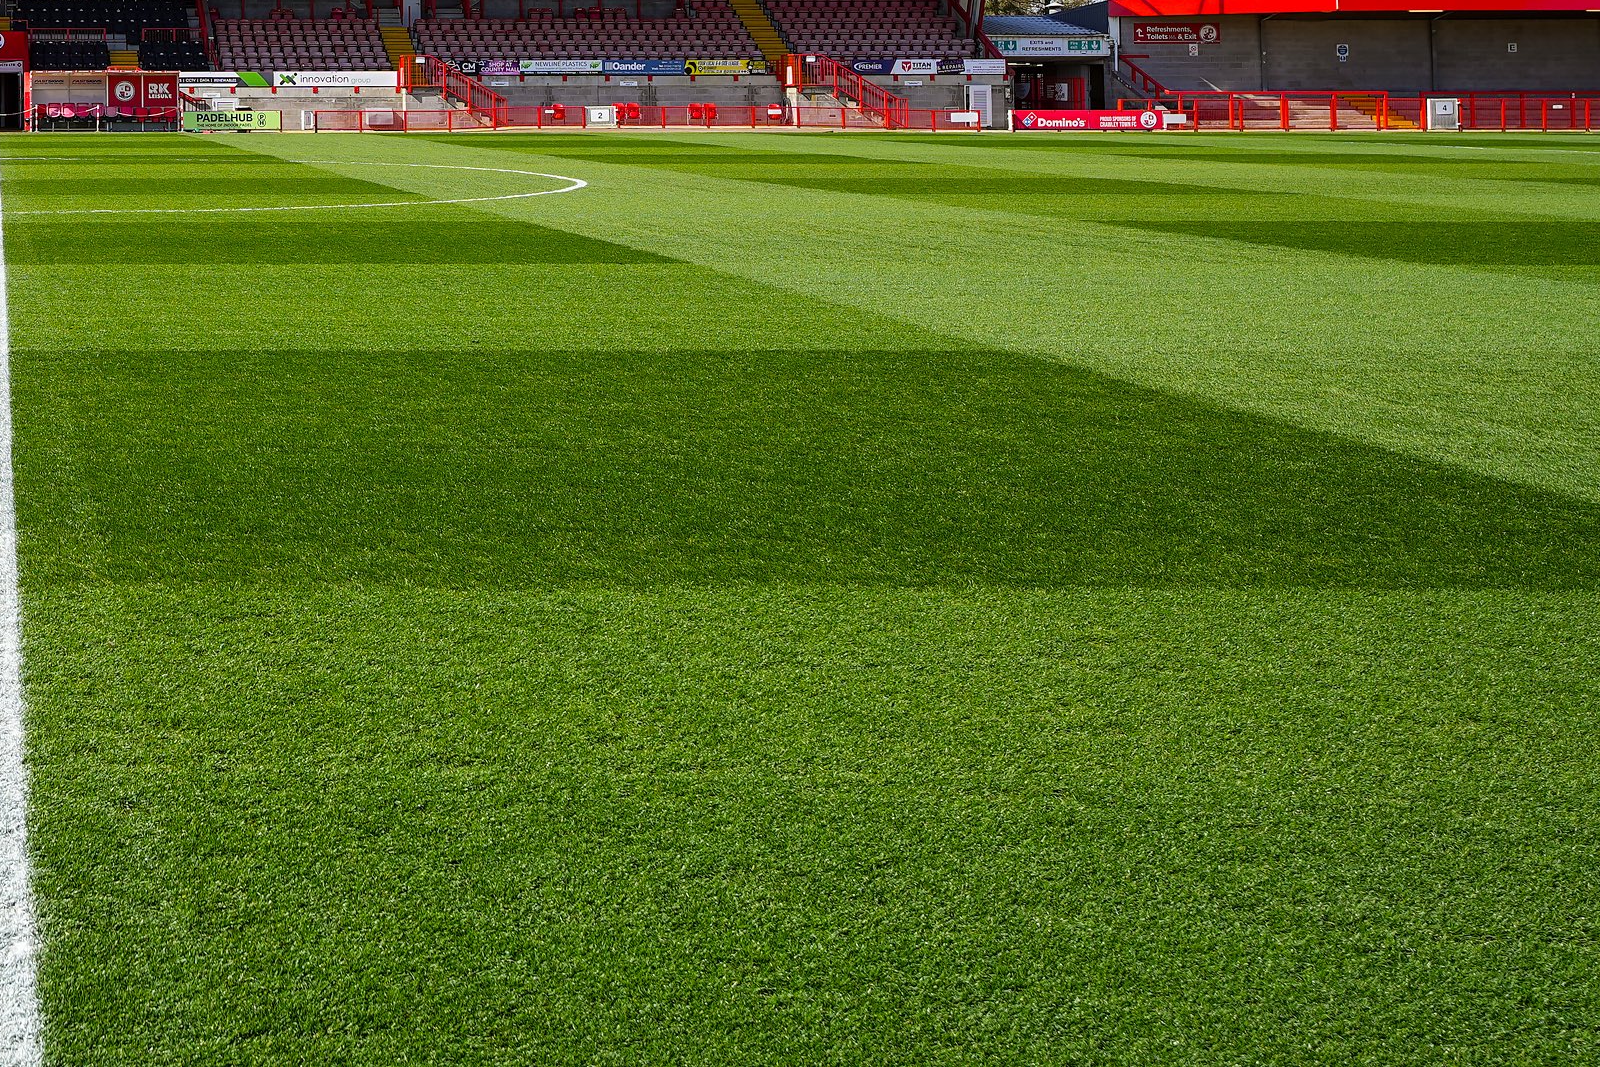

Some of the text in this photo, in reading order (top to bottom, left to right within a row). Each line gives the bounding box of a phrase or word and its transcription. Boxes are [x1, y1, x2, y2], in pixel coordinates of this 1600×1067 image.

[462, 62, 476, 70] CM
[612, 62, 646, 70] Oander
[858, 62, 883, 70] PREMIER
[300, 74, 350, 83] innovation
[148, 83, 170, 94] RK
[196, 113, 253, 122] PADELHUB
[1037, 117, 1086, 128] Domino's
